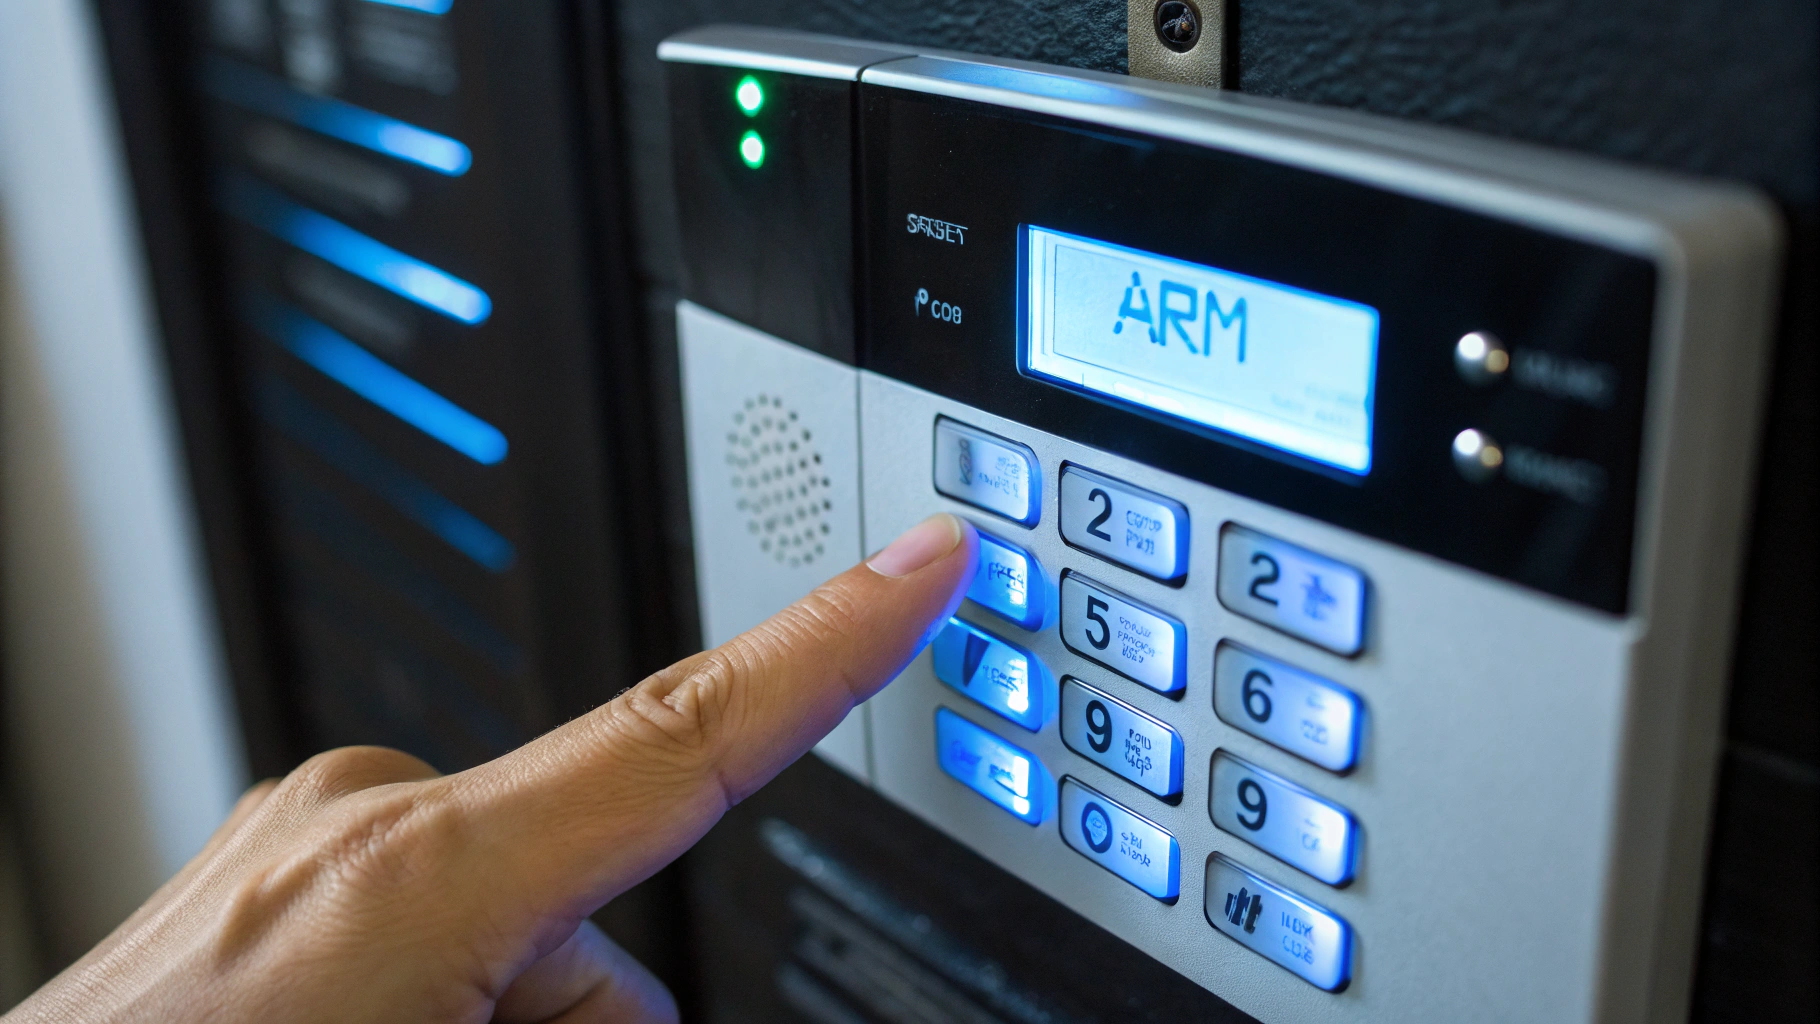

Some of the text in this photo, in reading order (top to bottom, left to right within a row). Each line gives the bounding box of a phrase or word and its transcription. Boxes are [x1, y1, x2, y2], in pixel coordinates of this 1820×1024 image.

[1112, 271, 1247, 363] ARM
[1086, 488, 1112, 542] 2
[1249, 552, 1280, 607] 2
[1085, 595, 1111, 650] 5
[1242, 669, 1273, 724] 6
[1086, 700, 1112, 753] 9
[1237, 778, 1268, 832] 9
